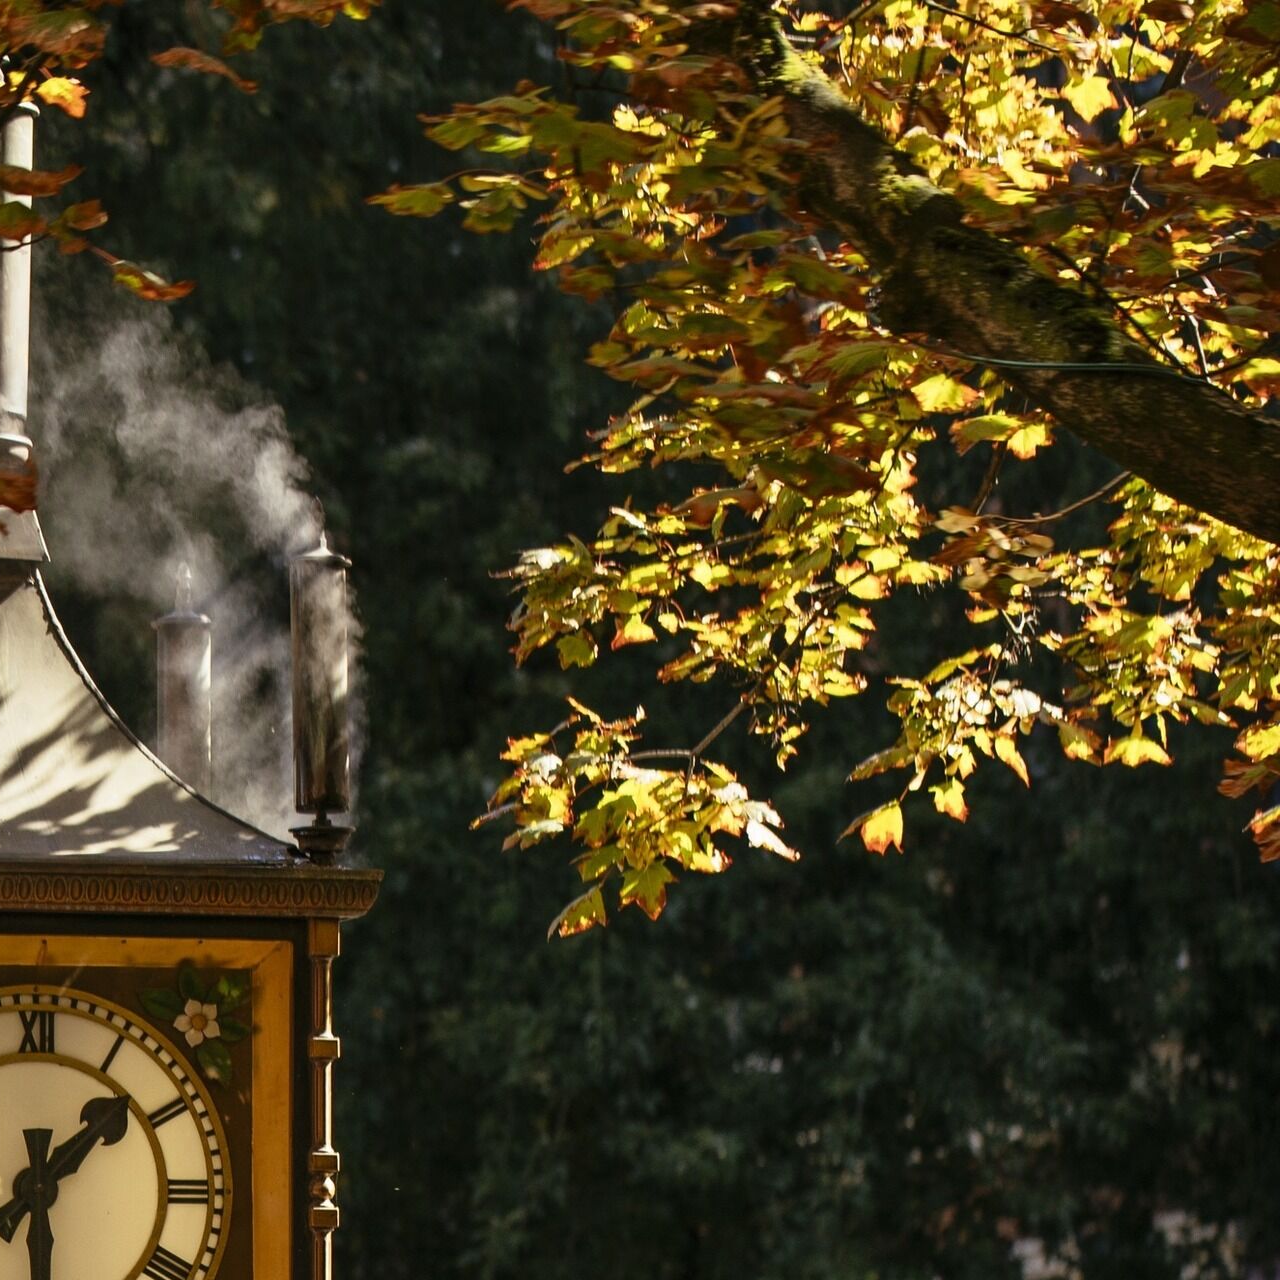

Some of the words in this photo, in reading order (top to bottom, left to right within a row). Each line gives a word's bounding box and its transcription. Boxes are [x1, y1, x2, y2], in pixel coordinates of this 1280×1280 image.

[19, 1011, 55, 1053] XII
[101, 1037, 124, 1072] I
[148, 1098, 186, 1128] II
[167, 1179, 208, 1204] III
